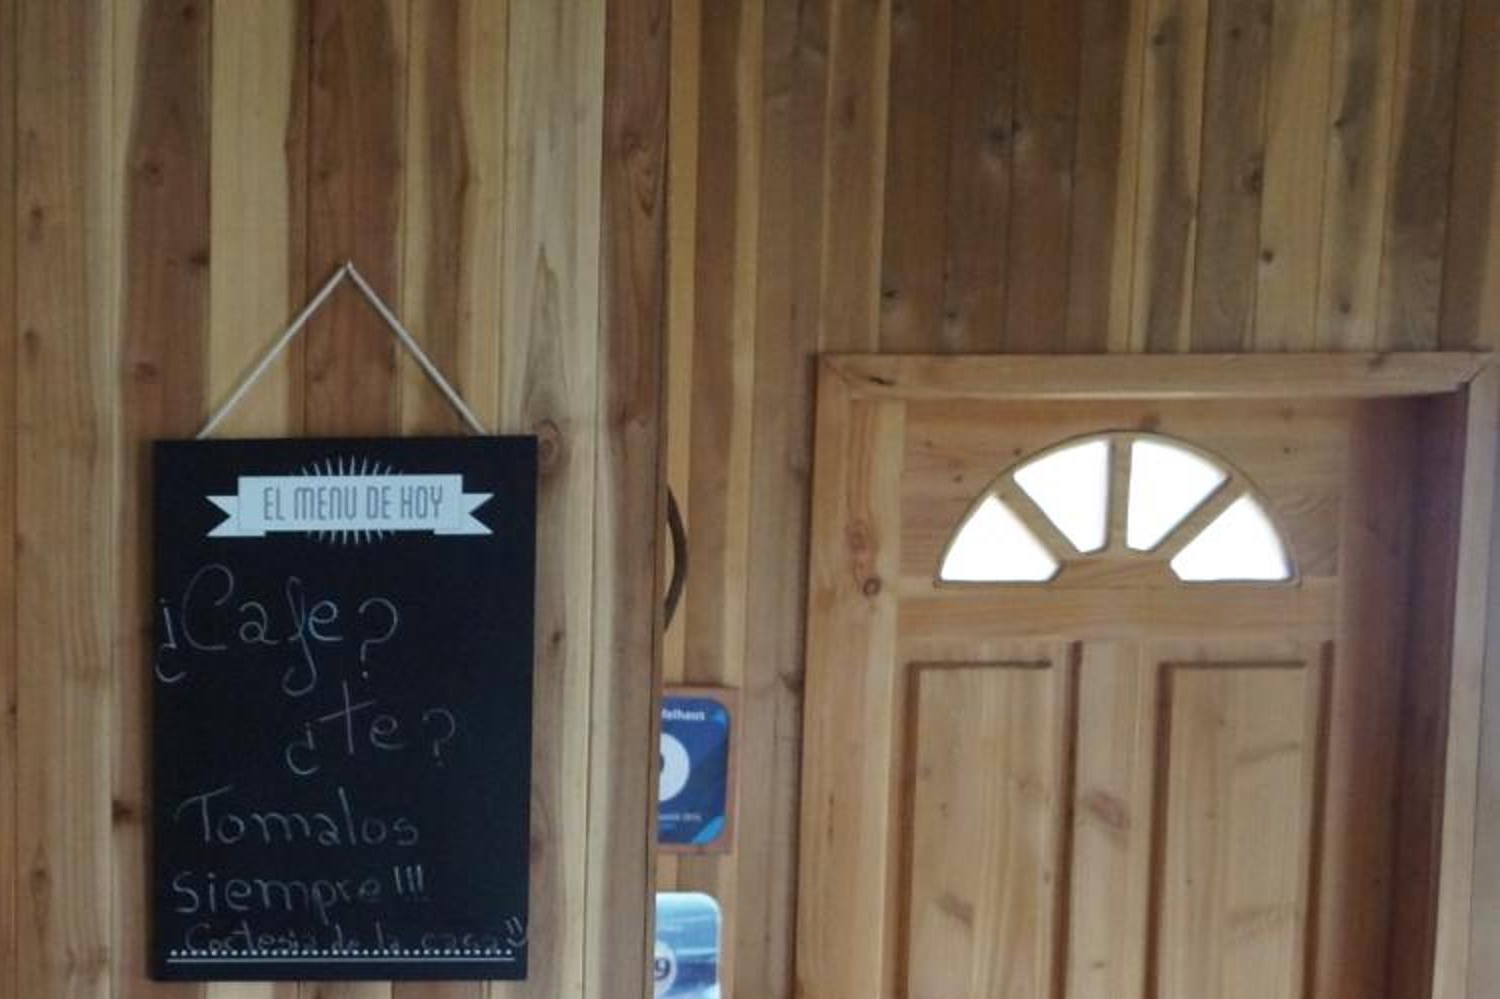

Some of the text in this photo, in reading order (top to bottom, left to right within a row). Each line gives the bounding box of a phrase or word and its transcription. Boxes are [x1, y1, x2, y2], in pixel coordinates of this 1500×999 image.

[263, 484, 444, 521] EL MENU DE HOY
[174, 785, 420, 847] Tomalos
